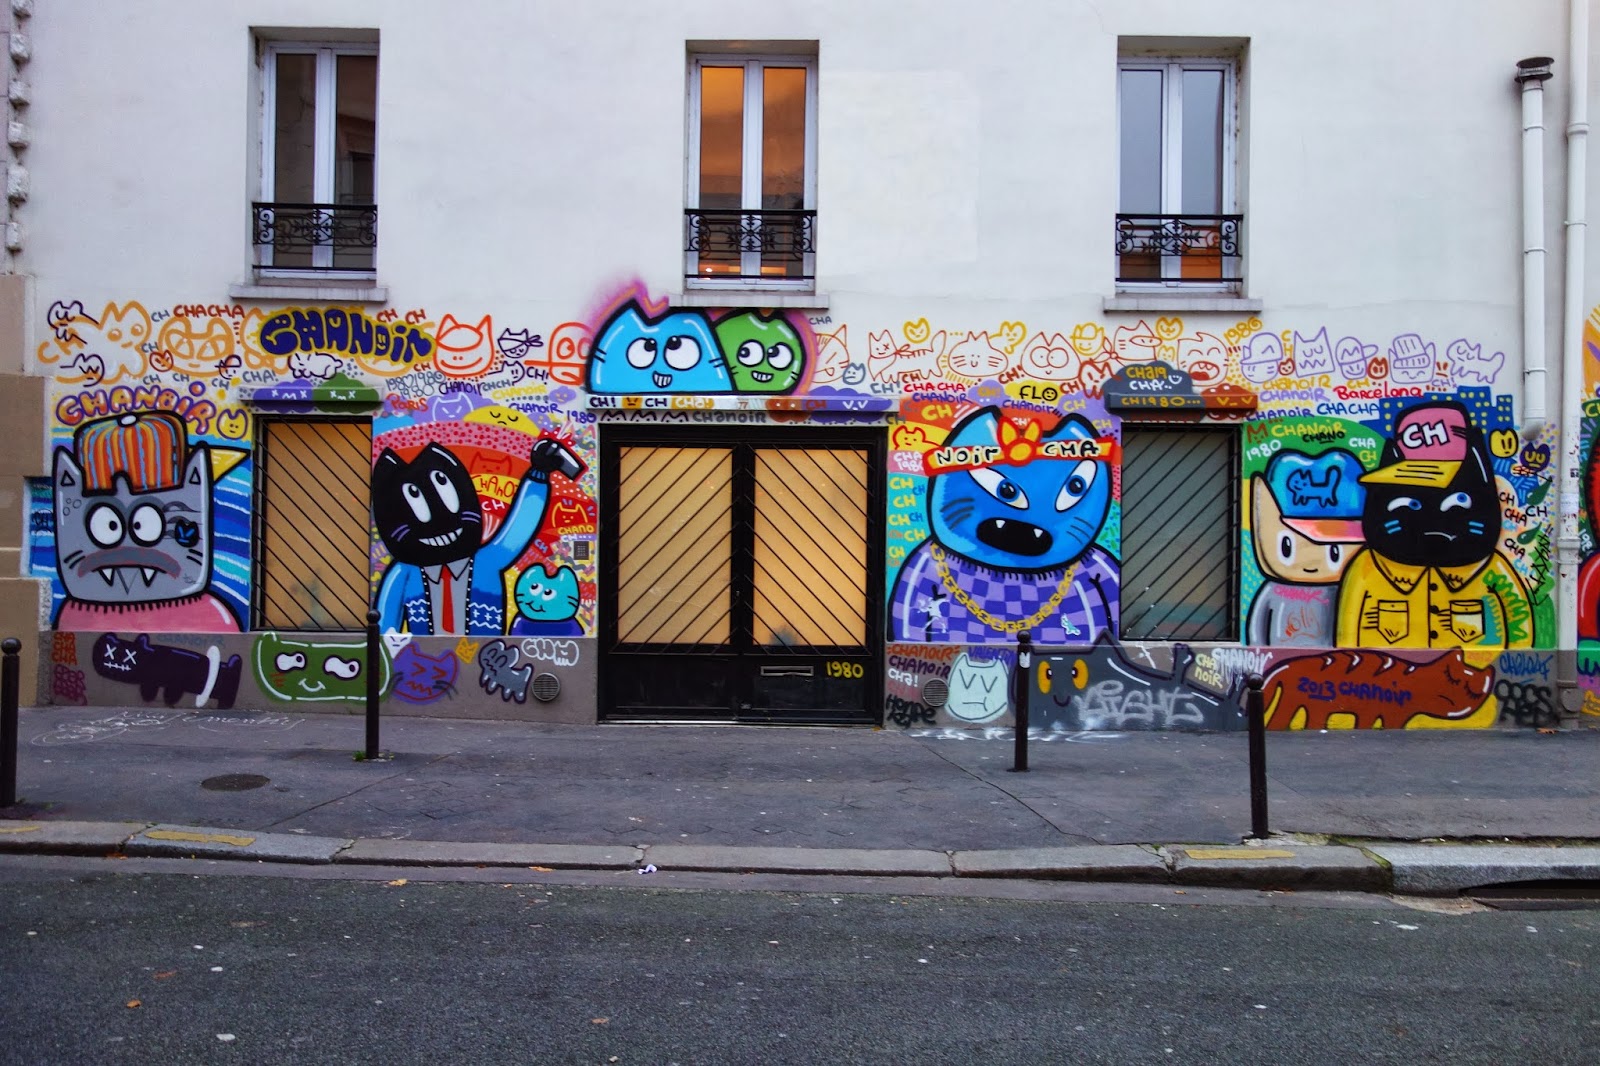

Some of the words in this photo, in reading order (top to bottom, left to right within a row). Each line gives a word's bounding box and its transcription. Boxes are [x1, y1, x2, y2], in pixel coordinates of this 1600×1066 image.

[173, 304, 245, 319] CHACHA
[376, 308, 398, 322] CH
[405, 309, 426, 325] CH
[809, 315, 832, 325] CHA
[141, 342, 159, 353] CH
[414, 362, 431, 372] CH
[902, 373, 921, 384] CH
[645, 397, 667, 408] CH
[567, 410, 597, 423] 1980
[921, 405, 953, 420] CH
[1402, 418, 1450, 449] CH
[1349, 437, 1376, 449] CHA
[1246, 440, 1282, 460] 1980
[889, 476, 914, 490] CH
[482, 499, 505, 511] CH
[893, 494, 917, 509] CH
[1525, 505, 1548, 518] CH
[888, 514, 911, 526] CH
[904, 528, 927, 542] CH
[888, 545, 906, 558] CH
[826, 661, 864, 679] 1980
[1298, 676, 1336, 702] 2013
